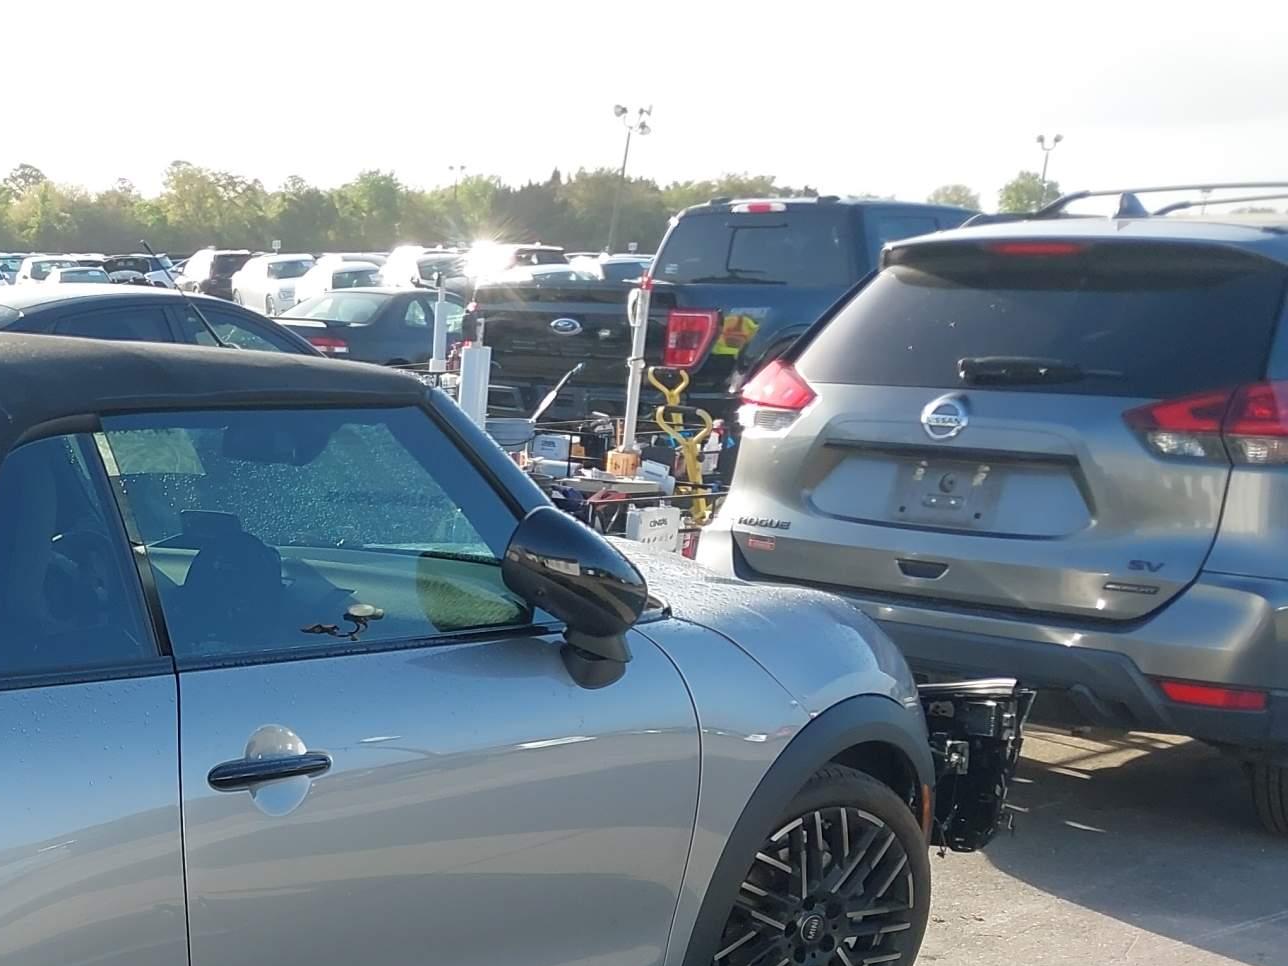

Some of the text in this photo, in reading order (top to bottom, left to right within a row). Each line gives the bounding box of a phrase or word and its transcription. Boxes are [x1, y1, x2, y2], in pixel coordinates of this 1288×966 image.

[738, 516, 791, 530] ROGUE
[1128, 559, 1165, 572] SV
[808, 919, 819, 940] MINI
